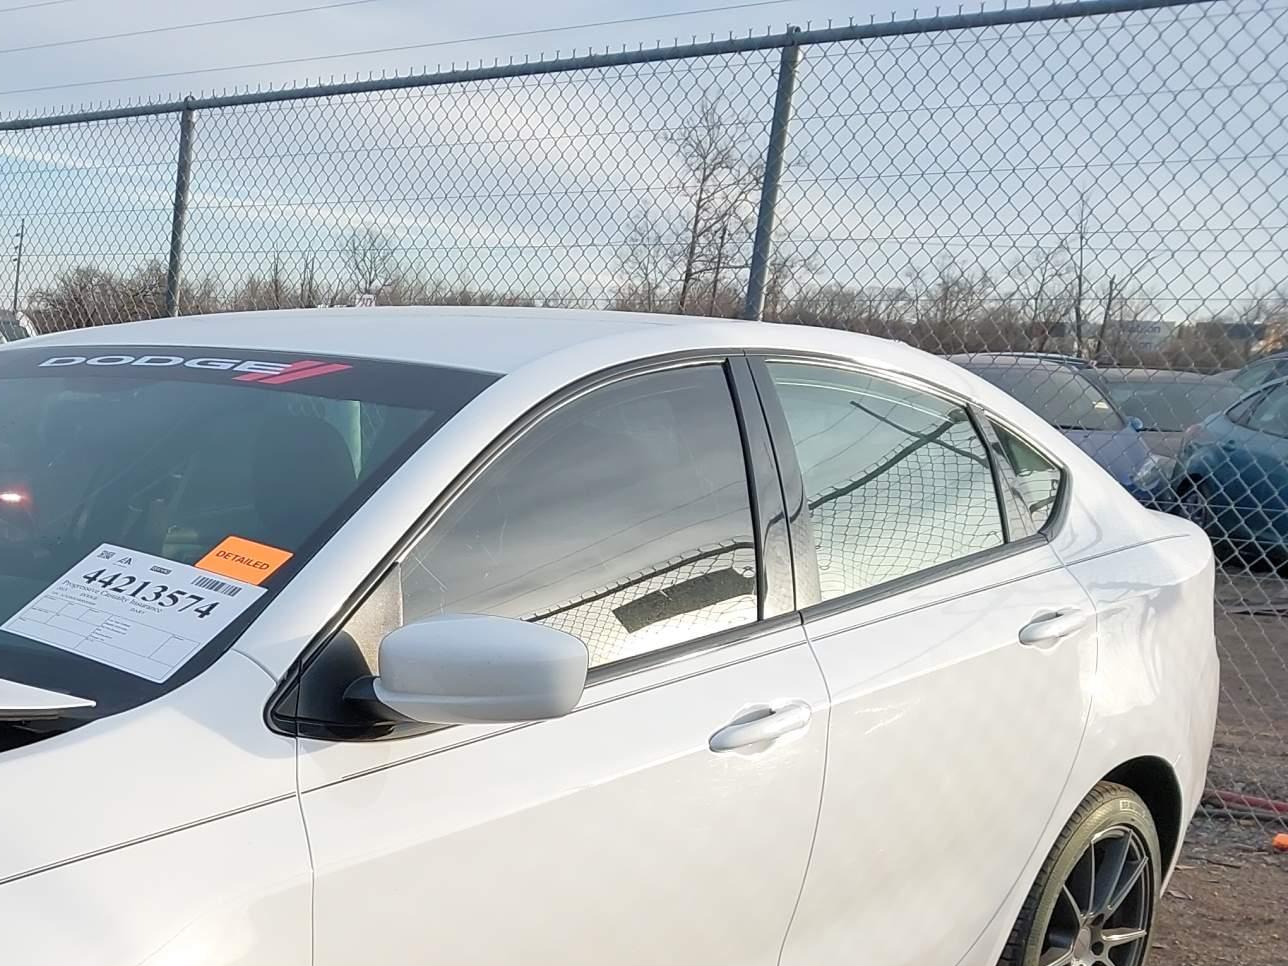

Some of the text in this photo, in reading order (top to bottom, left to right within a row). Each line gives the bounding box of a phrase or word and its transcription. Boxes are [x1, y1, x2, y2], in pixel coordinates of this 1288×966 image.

[38, 355, 295, 375] DODGE
[215, 549, 270, 571] DETAILED
[82, 568, 220, 619] 44213574
